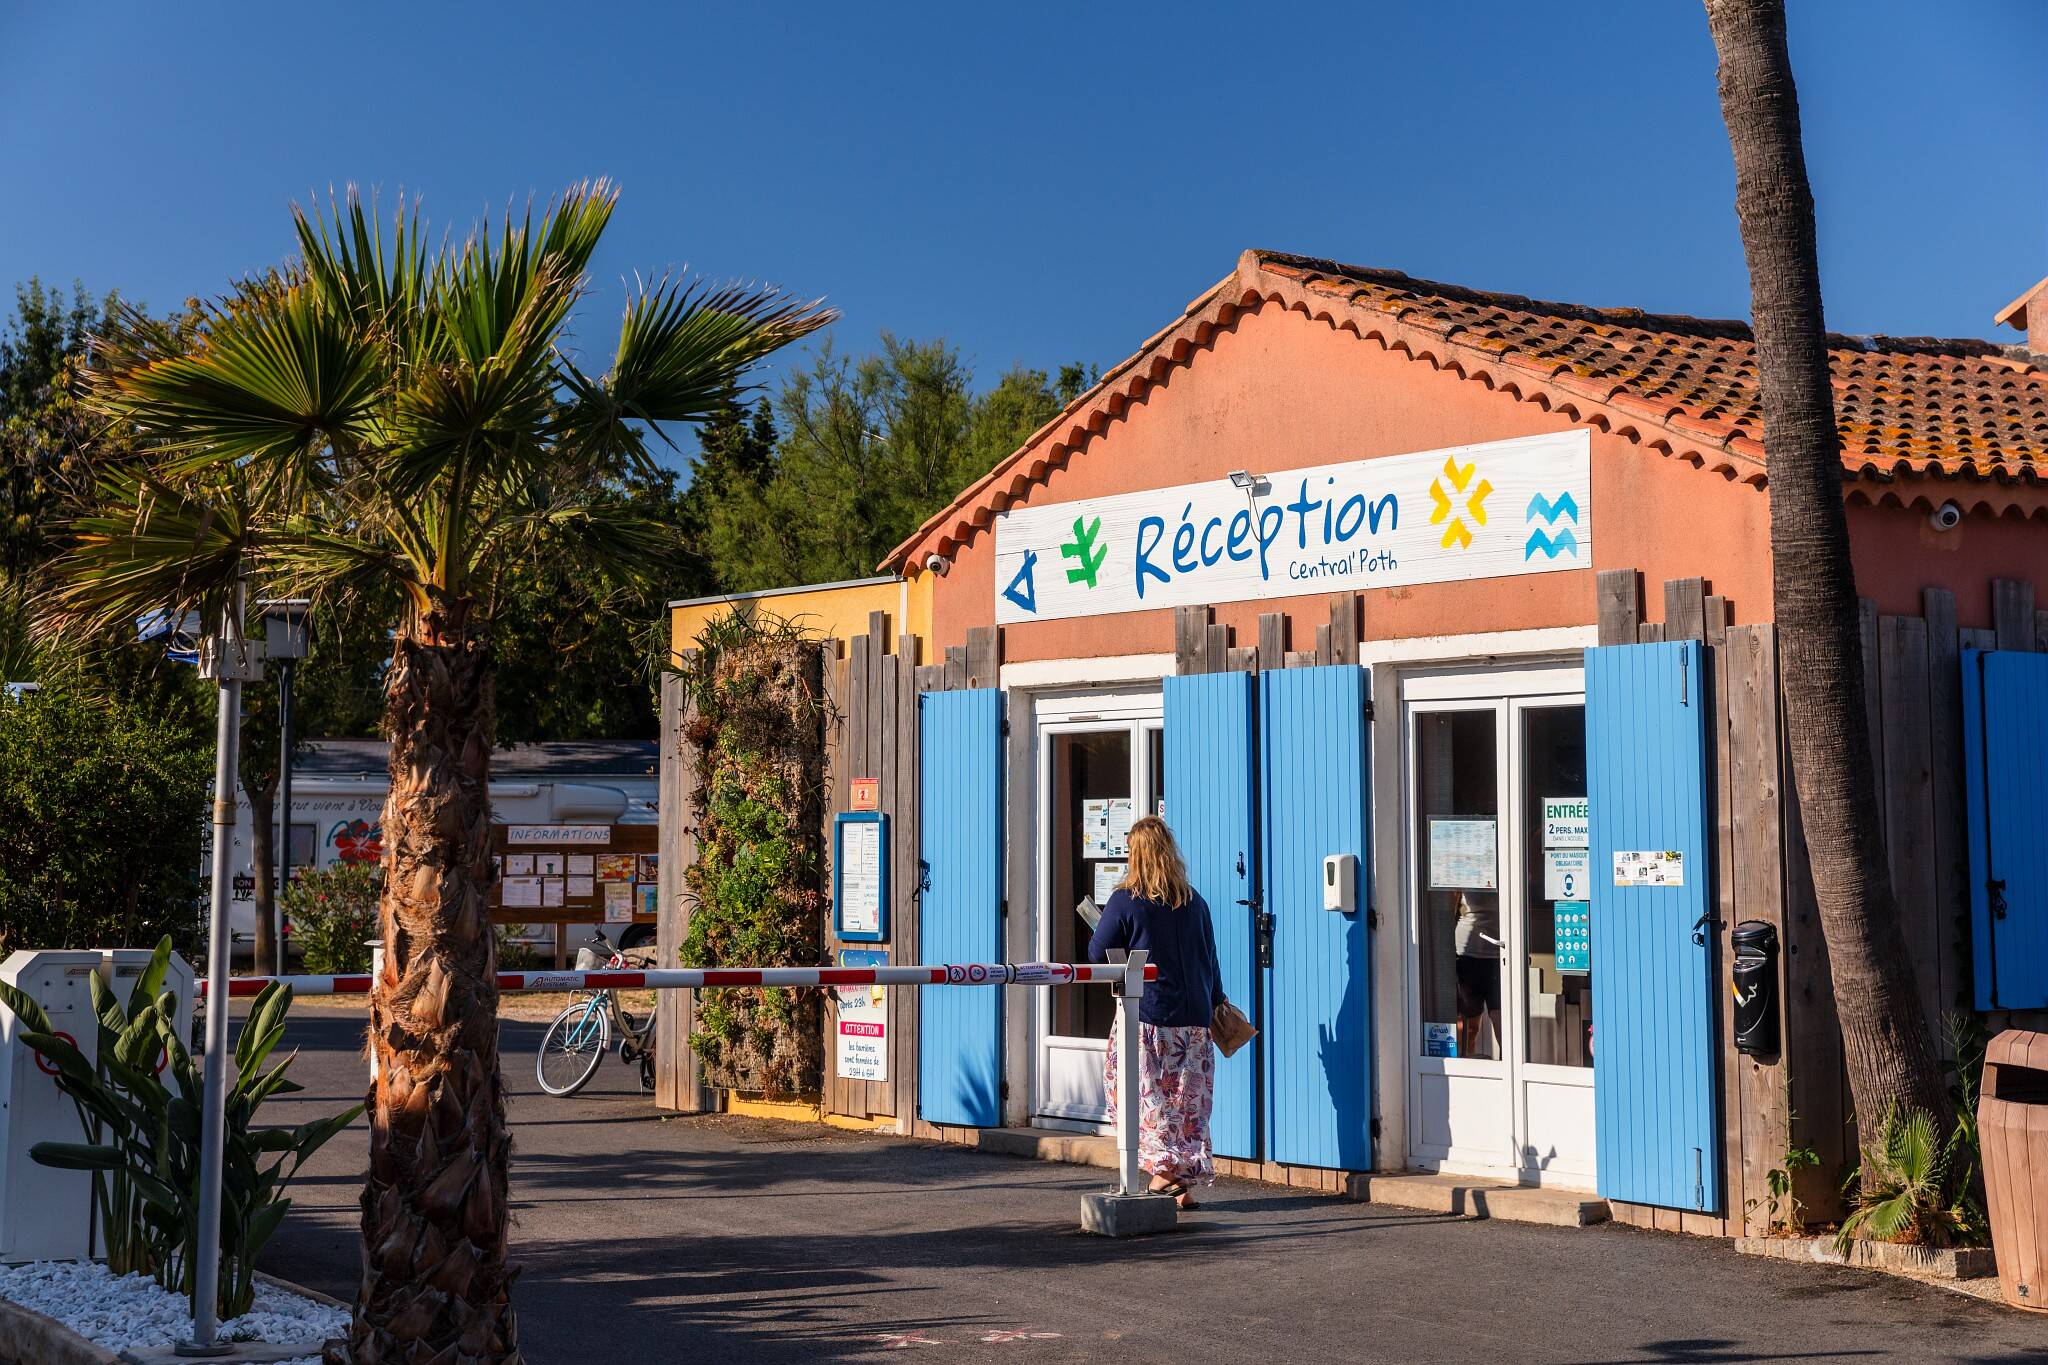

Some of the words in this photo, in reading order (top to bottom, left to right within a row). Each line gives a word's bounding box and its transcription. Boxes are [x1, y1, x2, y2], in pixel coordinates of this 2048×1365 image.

[1134, 476, 1399, 599] Réception
[1289, 548, 1398, 580] Central'Poth
[359, 798, 382, 812] Vou
[1547, 802, 1588, 818] ENTRÉE
[511, 829, 610, 841] INFORMATIONS
[1549, 824, 1554, 834] 2
[845, 1023, 879, 1035] ATTENTION
